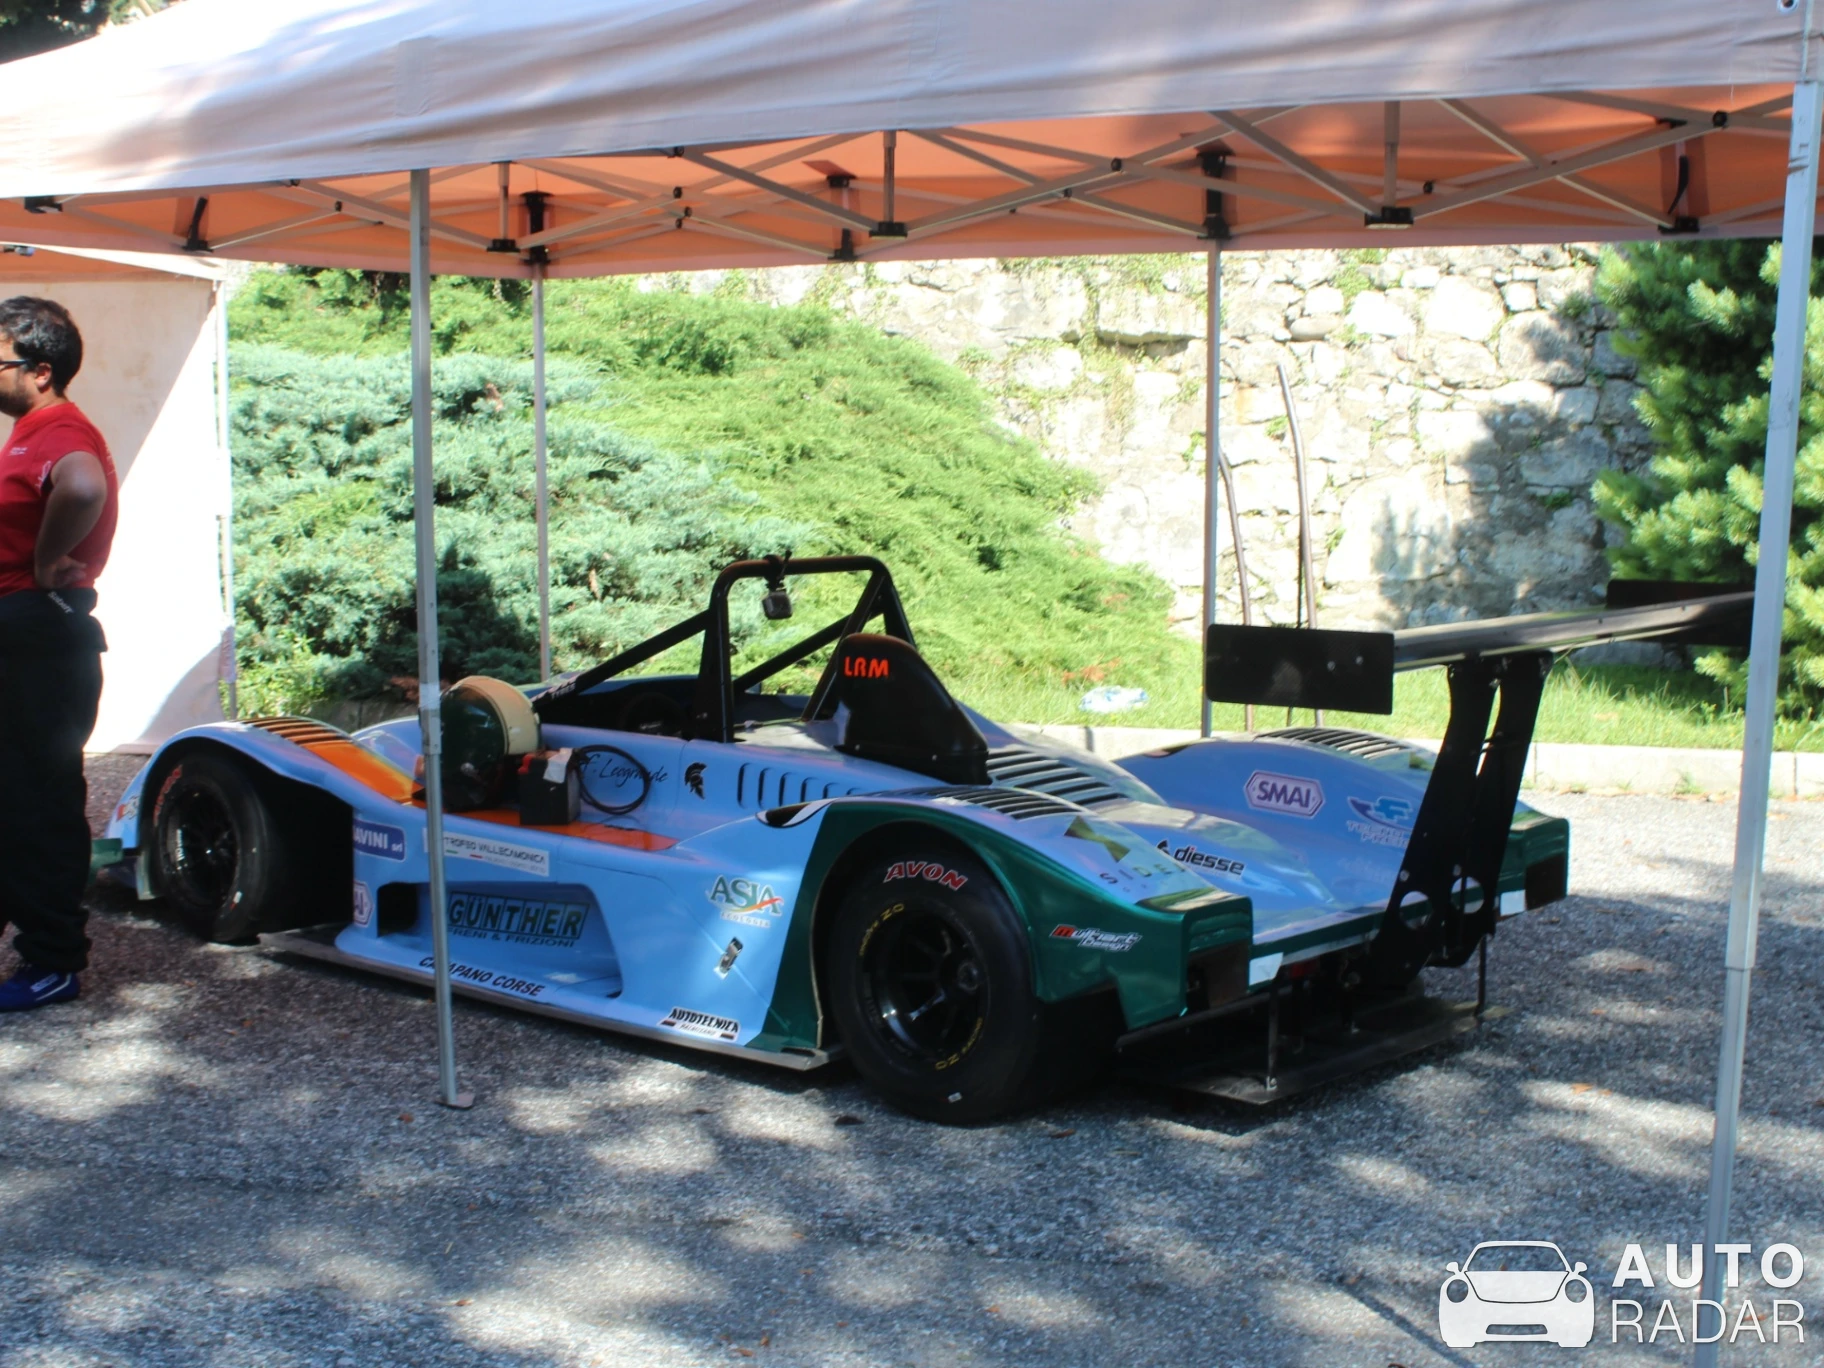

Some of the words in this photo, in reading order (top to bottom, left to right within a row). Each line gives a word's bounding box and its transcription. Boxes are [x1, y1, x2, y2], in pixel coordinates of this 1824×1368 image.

[844, 656, 888, 678] LRM
[1257, 781, 1311, 808] SMAI
[353, 827, 389, 849] AVINI
[1174, 846, 1245, 876] diesse
[883, 861, 968, 891] AVON
[710, 876, 784, 915] ASIA
[450, 897, 582, 936] GÜNTHER
[492, 932, 502, 942] &
[504, 934, 575, 948] FRIZIONI
[419, 957, 494, 983] CAAPANO
[493, 976, 546, 996] CORSE
[669, 1008, 739, 1033] AUTOTECNICA
